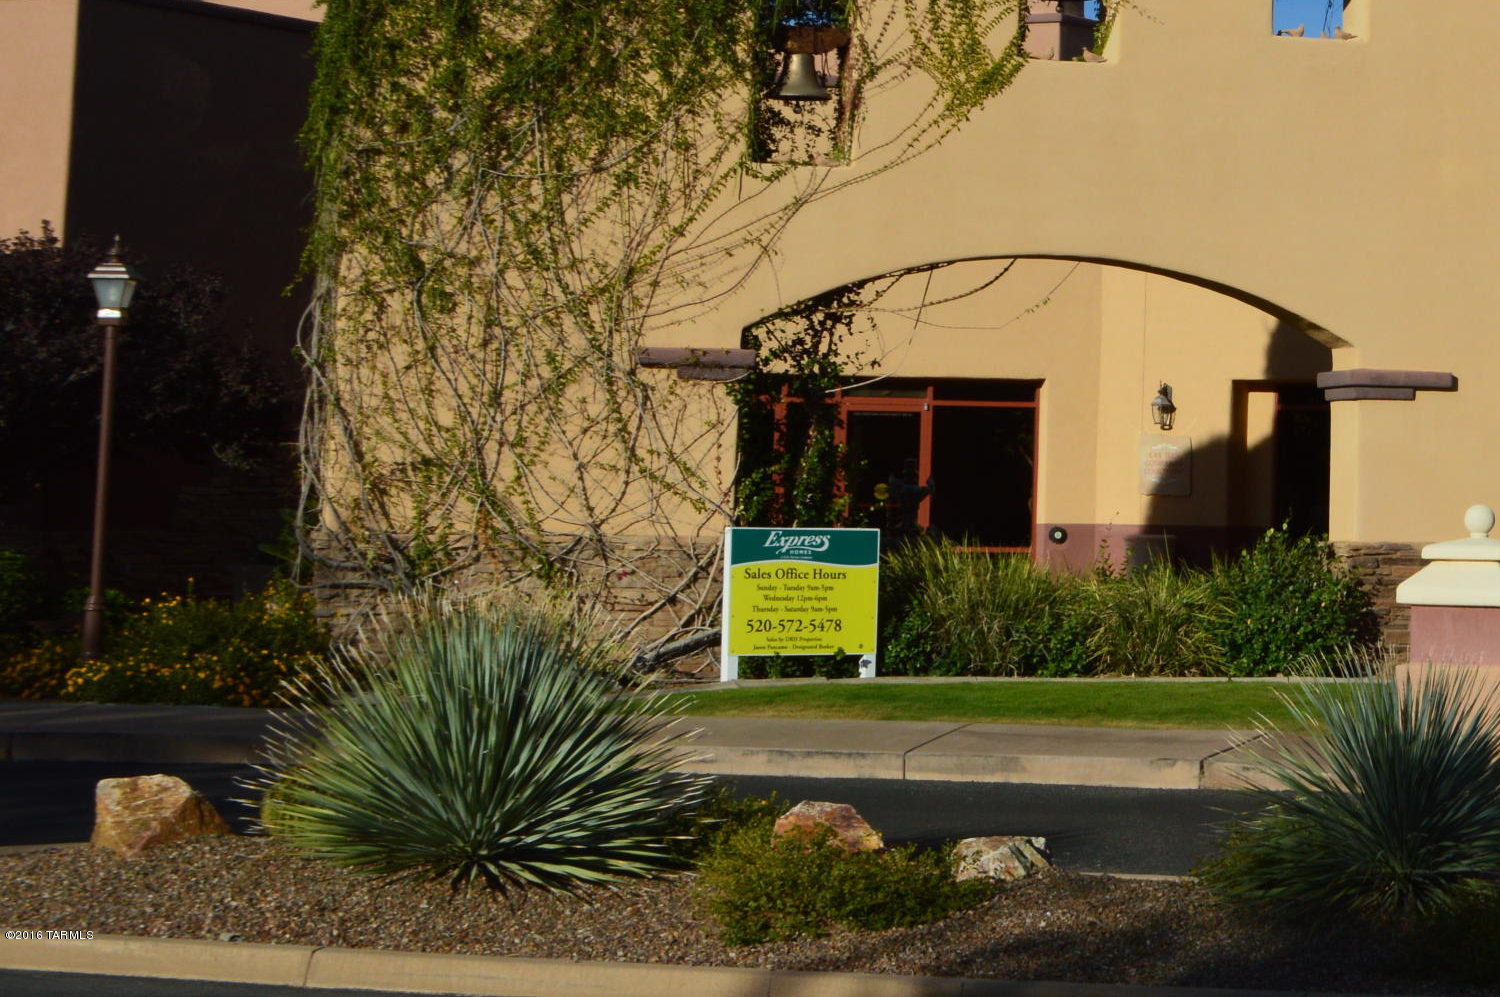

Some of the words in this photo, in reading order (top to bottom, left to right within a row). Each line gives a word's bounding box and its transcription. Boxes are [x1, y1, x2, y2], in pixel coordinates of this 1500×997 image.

[763, 531, 831, 554] Express
[744, 567, 772, 580] Sales
[775, 568, 809, 580] Office
[813, 568, 847, 580] Hours
[756, 584, 777, 592] Sunday
[783, 584, 805, 592] Tuesday
[763, 594, 794, 603] Wednesday
[752, 605, 779, 613] Thursday
[784, 605, 809, 613] Saturday
[746, 618, 842, 634] 520-572-5478
